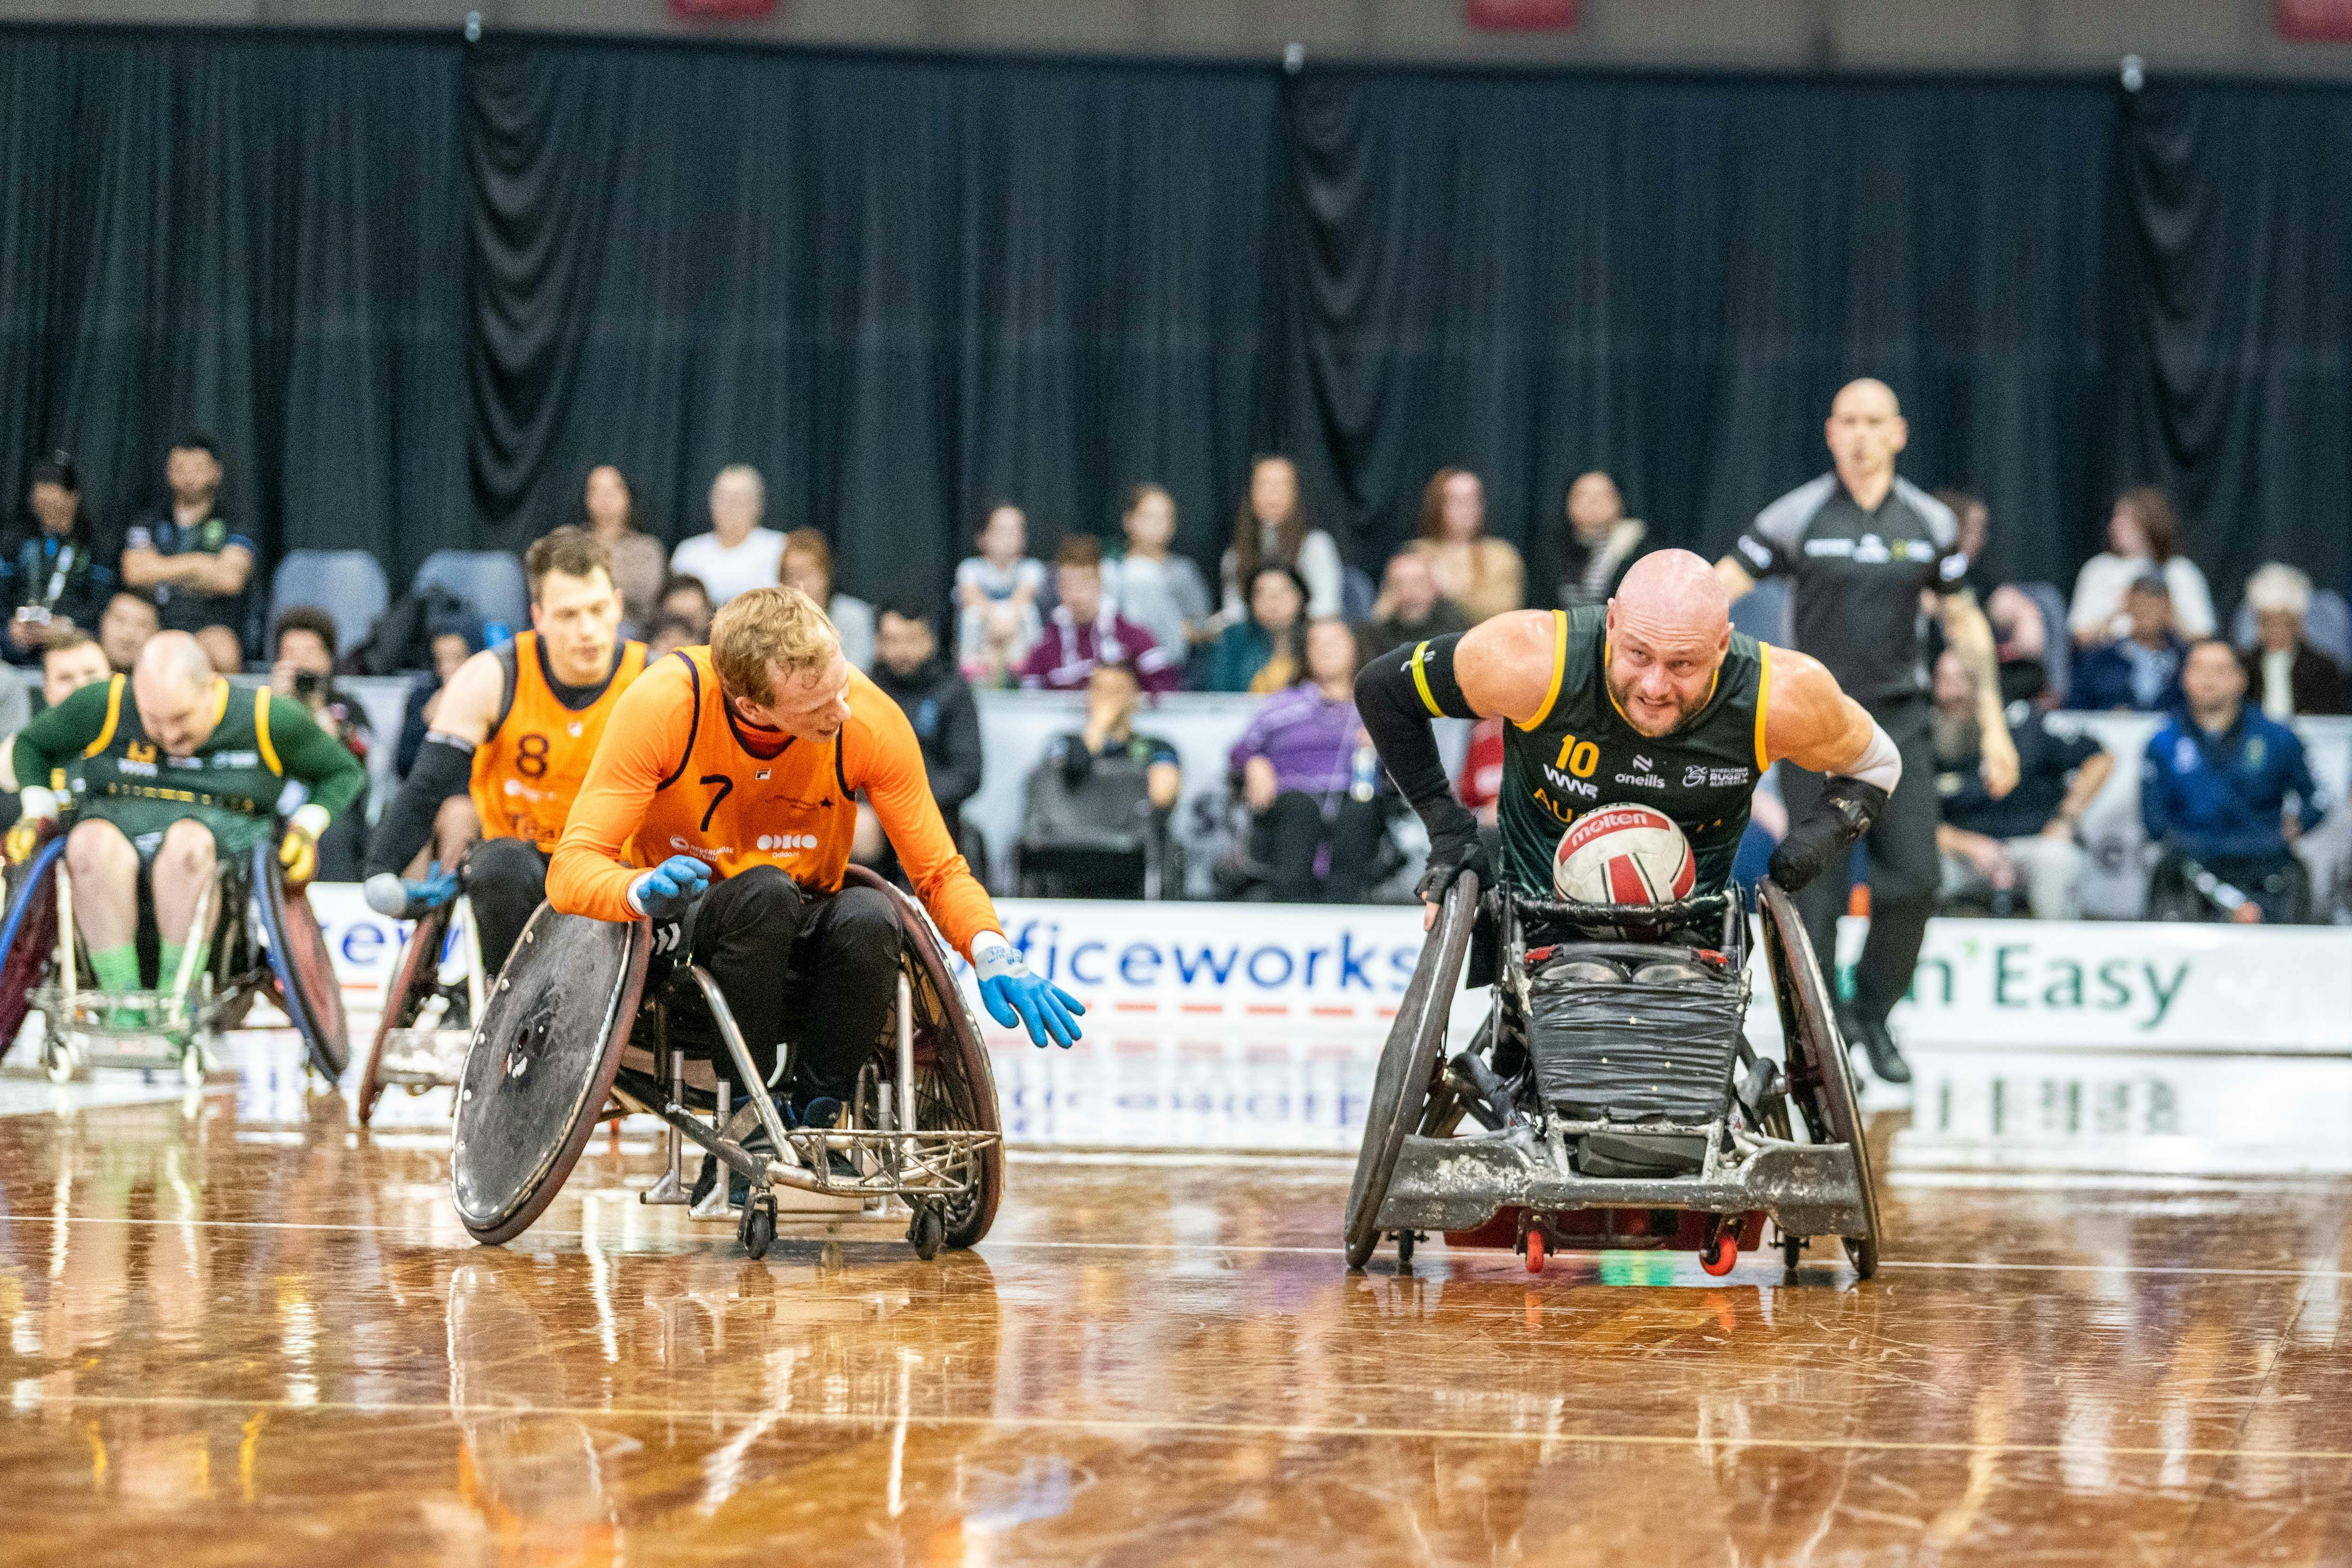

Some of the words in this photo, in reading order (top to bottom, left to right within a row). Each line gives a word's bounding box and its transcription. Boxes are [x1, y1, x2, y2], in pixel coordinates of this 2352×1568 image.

[516, 733, 549, 779] 8
[1555, 734, 1599, 778] 10
[1710, 772, 1749, 781] RUGBY
[699, 774, 733, 832] 7
[1571, 812, 1647, 846] molten
[941, 918, 1421, 992] ficeworks
[1994, 942, 2192, 1032] Easy
